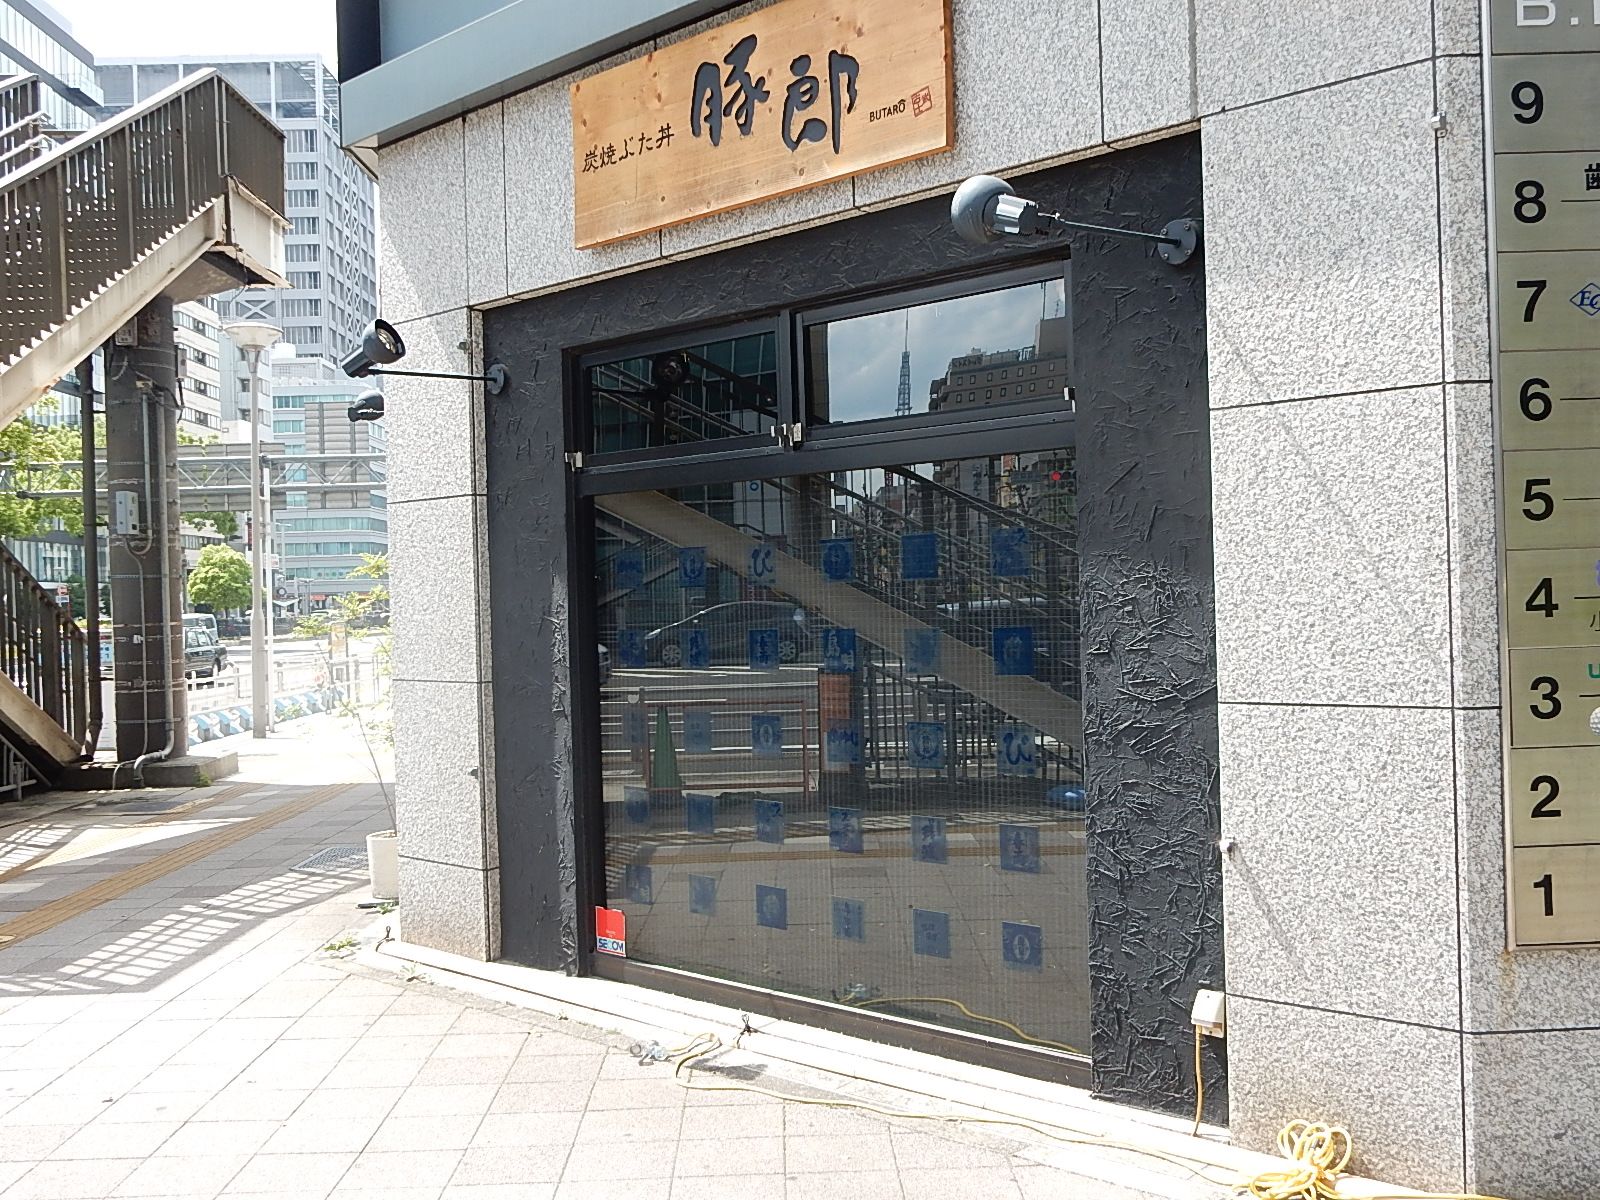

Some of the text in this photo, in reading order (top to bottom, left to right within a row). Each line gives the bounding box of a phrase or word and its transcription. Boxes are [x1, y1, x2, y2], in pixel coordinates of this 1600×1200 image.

[690, 33, 860, 154] 豚郎
[1510, 81, 1544, 124] 9
[582, 122, 675, 173] 炭焼ぶた丼
[1513, 180, 1547, 223] 8
[1516, 280, 1547, 323] 7
[1519, 378, 1552, 421] 6
[1522, 478, 1554, 521] 5
[1525, 577, 1559, 618] 4
[1529, 676, 1562, 719] 3
[1530, 775, 1562, 818] 2
[1533, 874, 1554, 916] 1
[598, 938, 624, 952] SECOM
